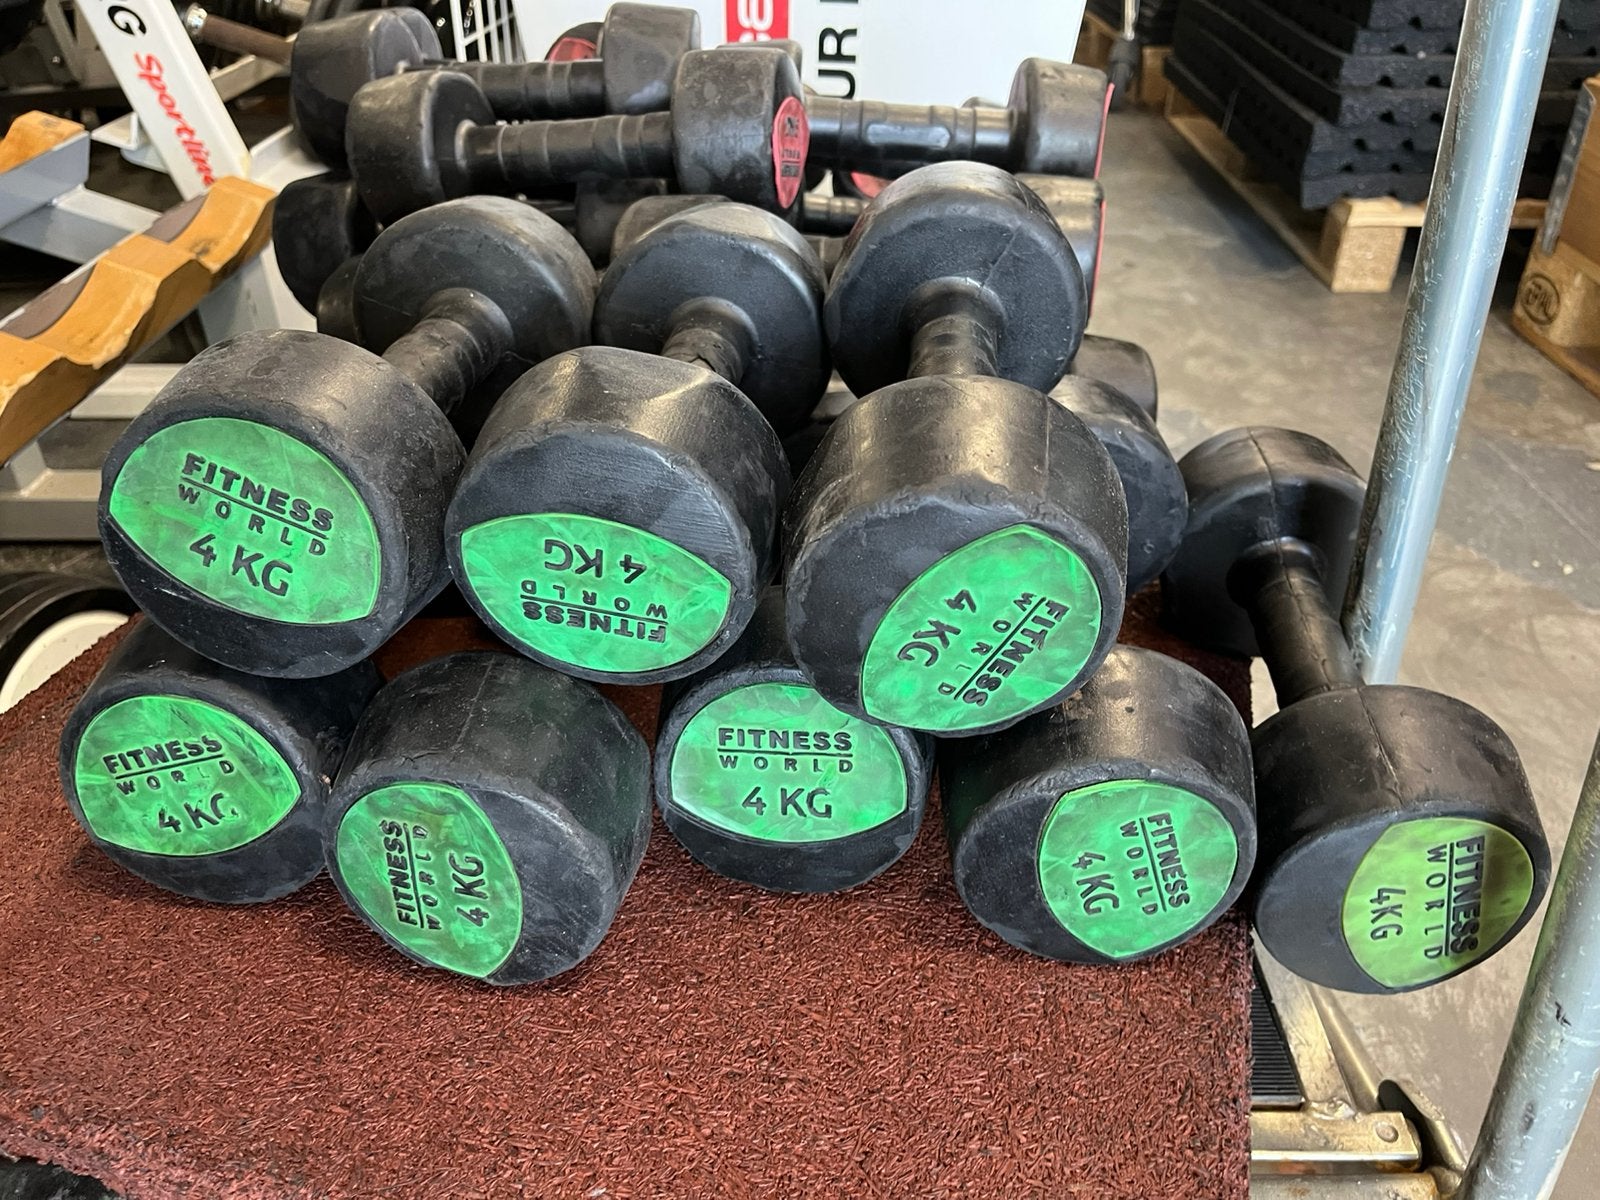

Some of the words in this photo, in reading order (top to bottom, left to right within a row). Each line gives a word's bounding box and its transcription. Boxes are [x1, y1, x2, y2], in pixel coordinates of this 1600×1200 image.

[181, 452, 334, 532] FITNESS
[178, 483, 326, 556] WORLD
[189, 533, 217, 568] 4
[231, 544, 293, 596] KG
[544, 539, 604, 578] KG
[619, 554, 648, 584] 4
[520, 579, 668, 620] WORLD
[944, 589, 976, 613] 4
[522, 601, 667, 644] FITNESS
[897, 619, 961, 667] KG
[938, 592, 1036, 695] WORLD
[962, 599, 1070, 707] FITNESS
[102, 735, 223, 774] FITNESS
[718, 727, 852, 751] FITNESS
[116, 760, 235, 795] WORLD
[719, 755, 853, 773] WORLD
[158, 806, 182, 832] 4
[742, 786, 766, 816] 4
[780, 788, 832, 819] KG
[379, 820, 418, 926] FITNESS
[413, 825, 442, 930] WORLD
[449, 852, 489, 900] KG
[1072, 852, 1105, 870] 4
[1120, 820, 1158, 915] WORLD
[1147, 812, 1190, 908] FITNESS
[1076, 874, 1119, 915] KG
[1424, 844, 1447, 959] WORLD
[1450, 835, 1485, 954] FITNESS
[456, 907, 489, 927] 4
